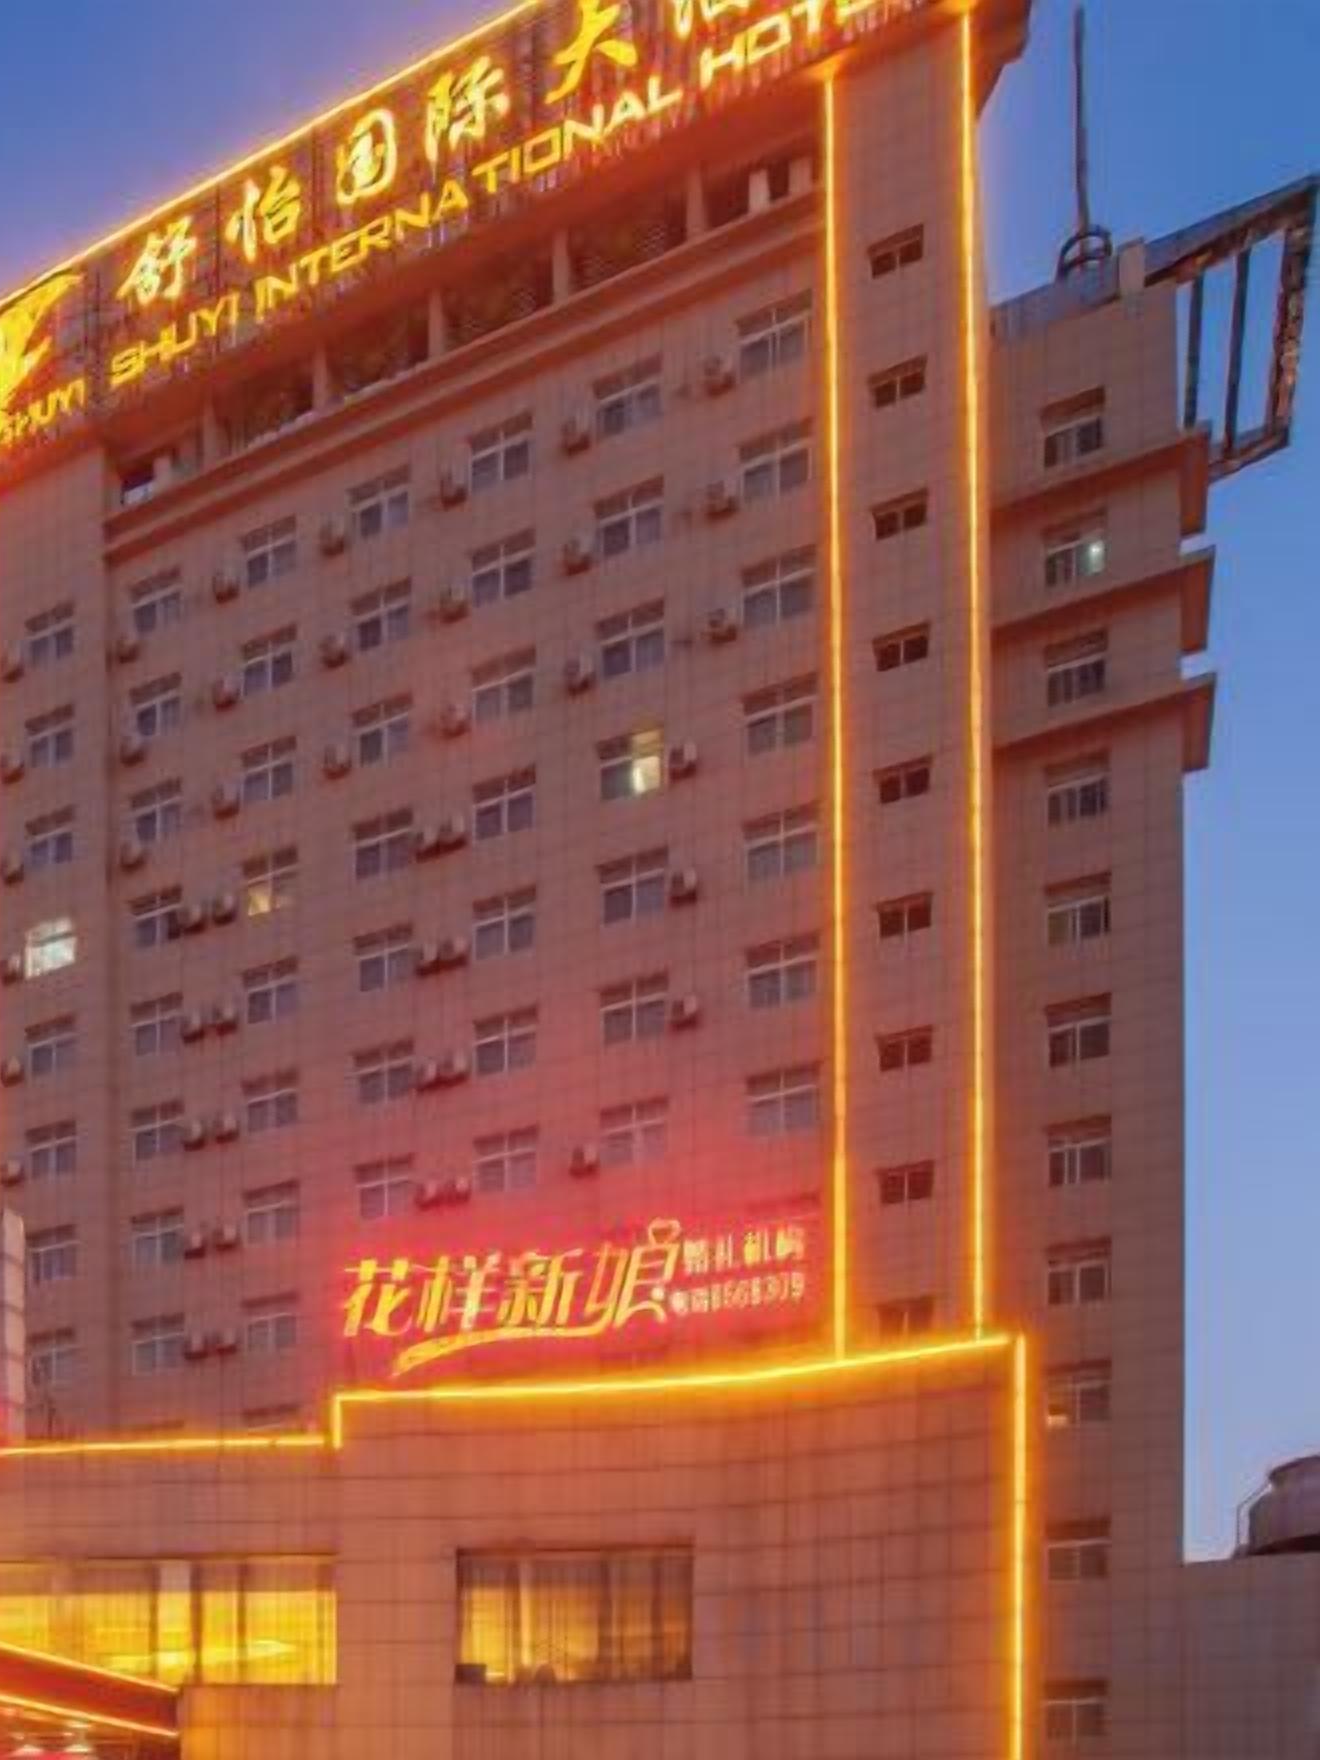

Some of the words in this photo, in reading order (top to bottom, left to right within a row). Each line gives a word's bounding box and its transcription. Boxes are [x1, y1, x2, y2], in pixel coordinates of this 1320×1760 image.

[109, 291, 240, 388] SHUYI
[255, 73, 684, 324] INTERNATIONAL
[341, 1217, 681, 1378] 花样新娘
